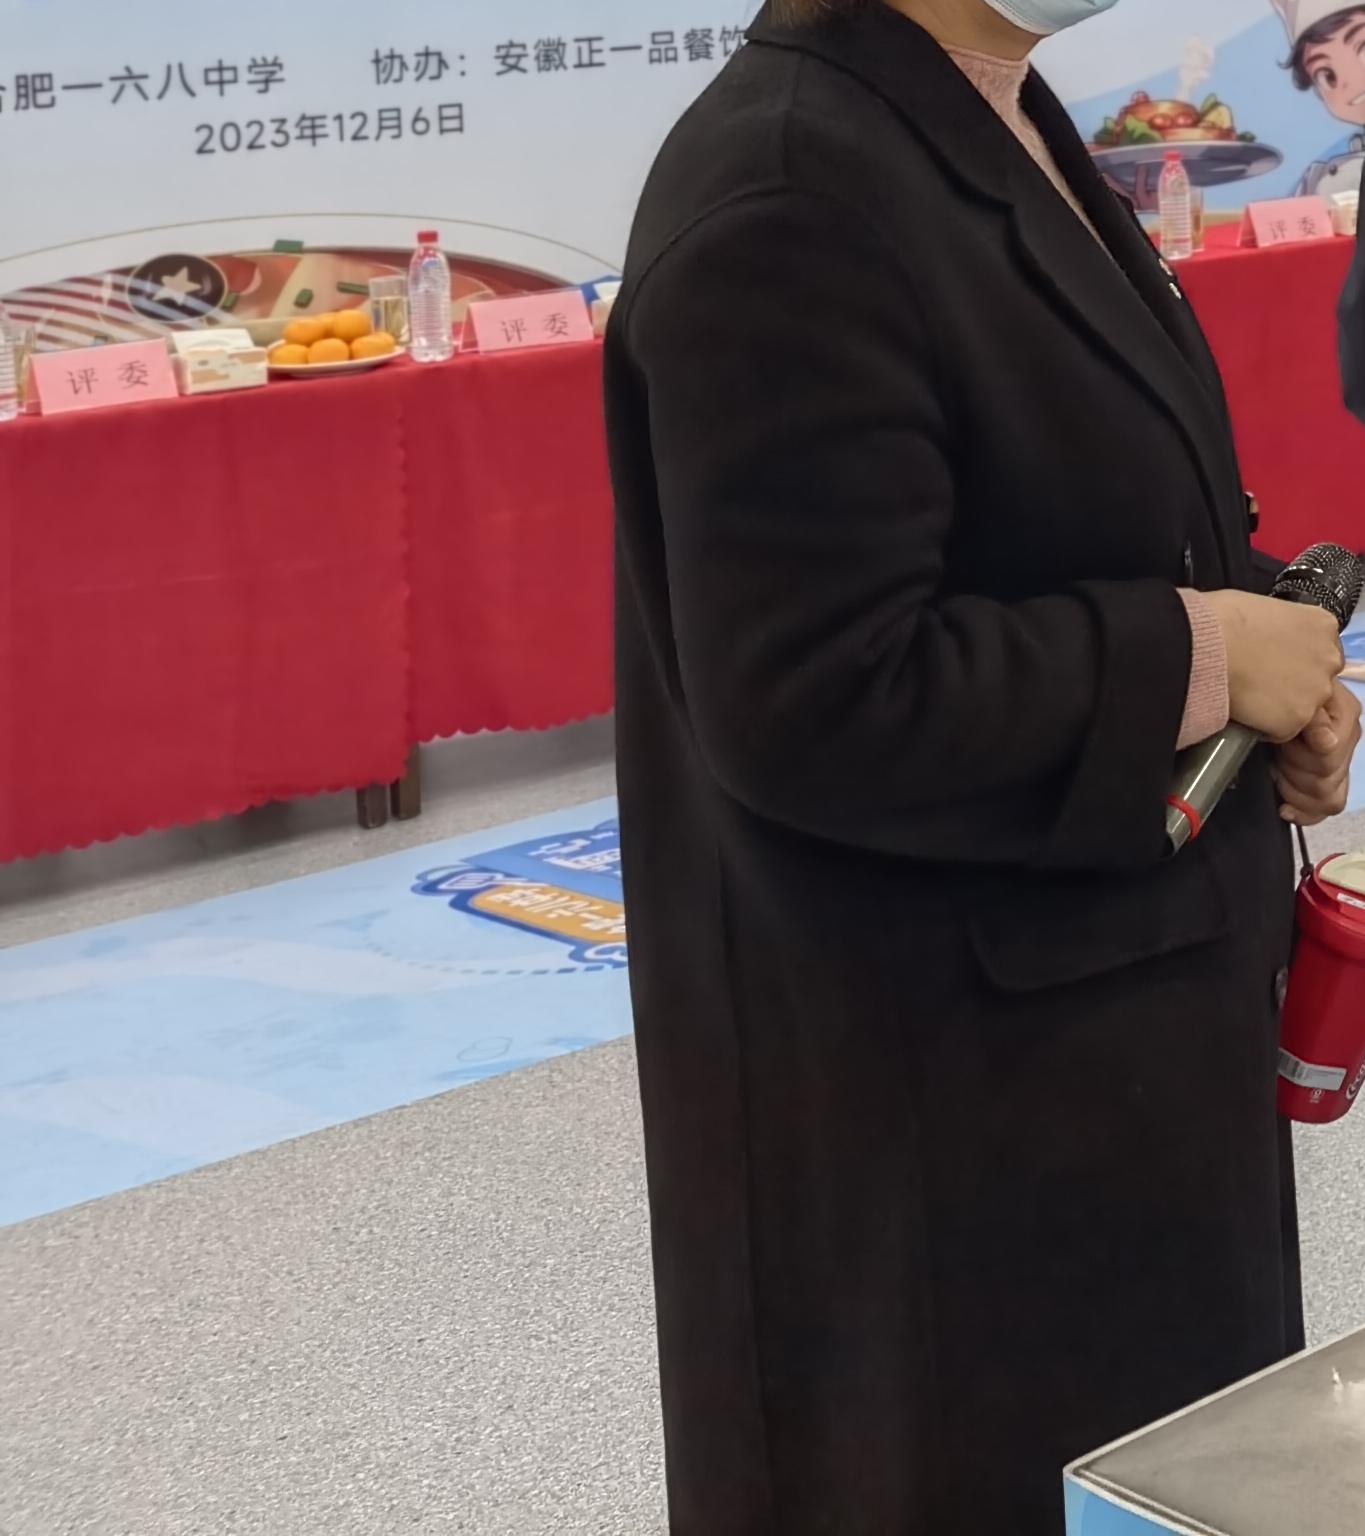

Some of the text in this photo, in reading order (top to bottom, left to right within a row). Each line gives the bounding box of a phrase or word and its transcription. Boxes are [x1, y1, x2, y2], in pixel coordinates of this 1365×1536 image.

[0, 56, 286, 113] 肥一六八中学
[195, 103, 467, 156] 2023年12月6日
[1269, 215, 1316, 241] 评委
[501, 313, 570, 345] 评委
[67, 359, 149, 396] 评委
